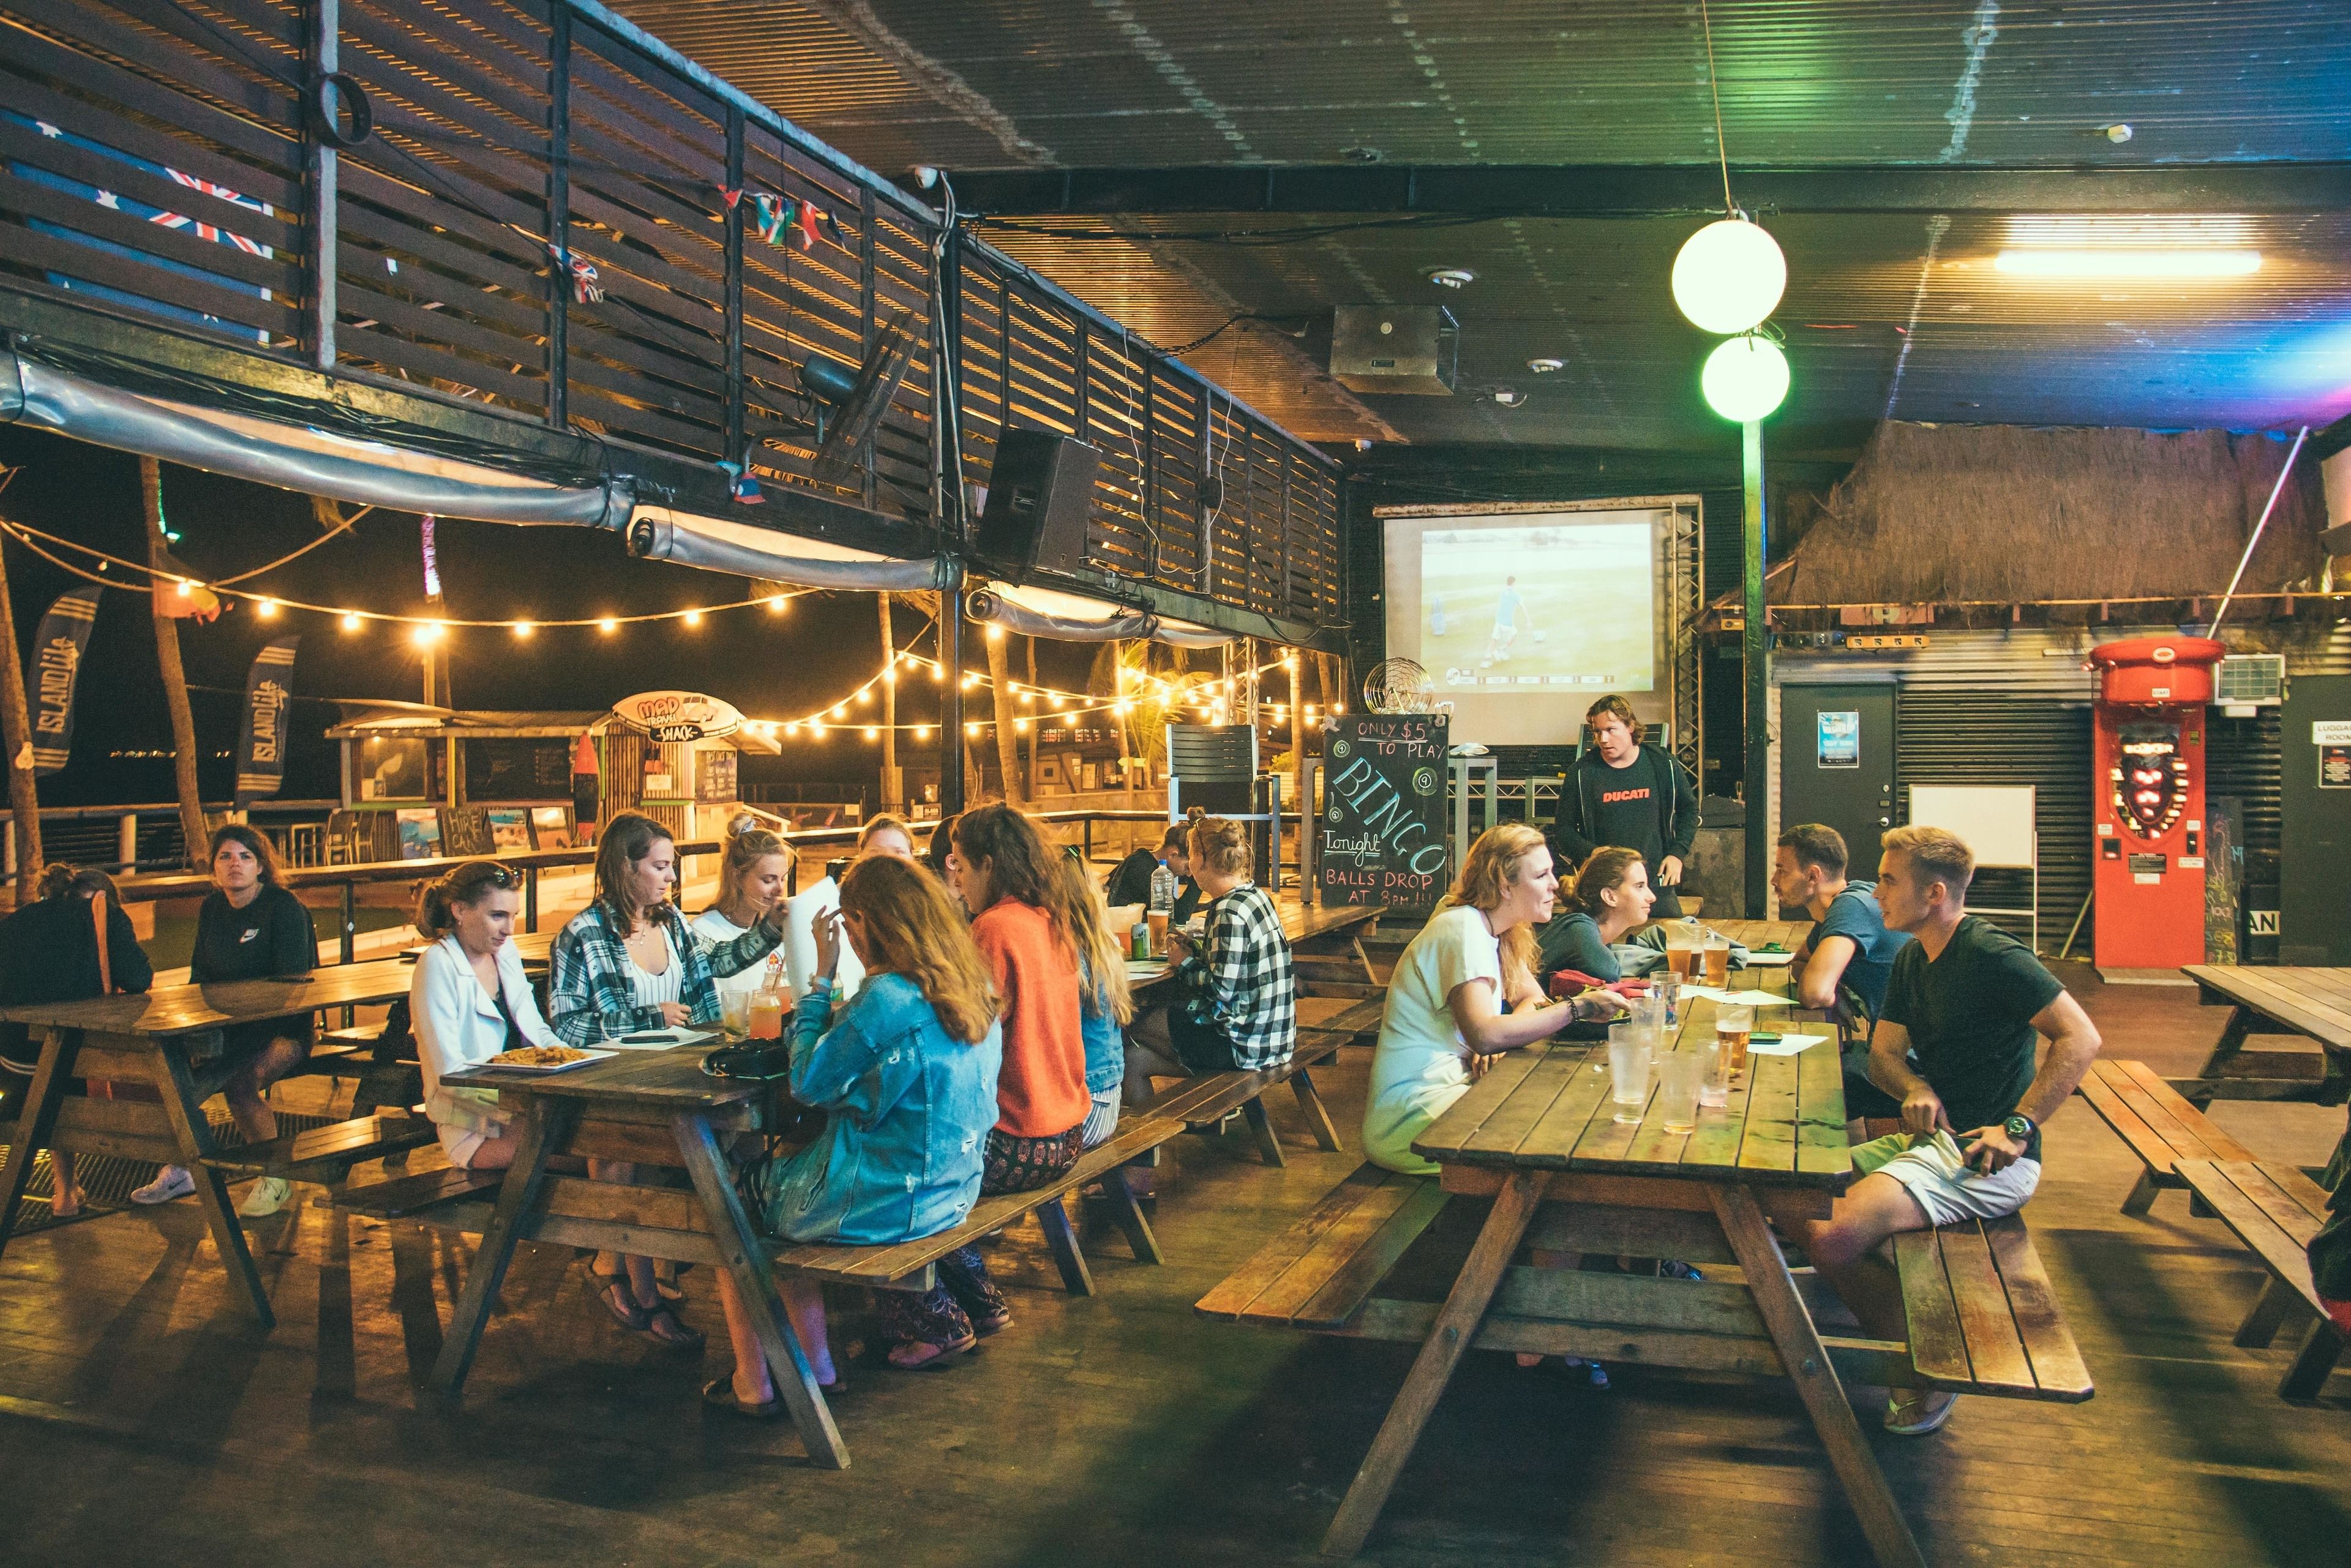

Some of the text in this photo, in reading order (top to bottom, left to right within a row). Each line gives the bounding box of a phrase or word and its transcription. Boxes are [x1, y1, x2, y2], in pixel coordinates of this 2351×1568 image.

[637, 697, 680, 718] MAD
[1358, 722, 1397, 737] ONLY
[1377, 742, 1445, 760] TO PLAY
[1603, 788, 1650, 803] DUCATI
[1332, 757, 1446, 876] BINGO
[1323, 830, 1381, 867] Tonight
[1326, 869, 1433, 890] BALLS DROP
[1348, 890, 1370, 903] AT
